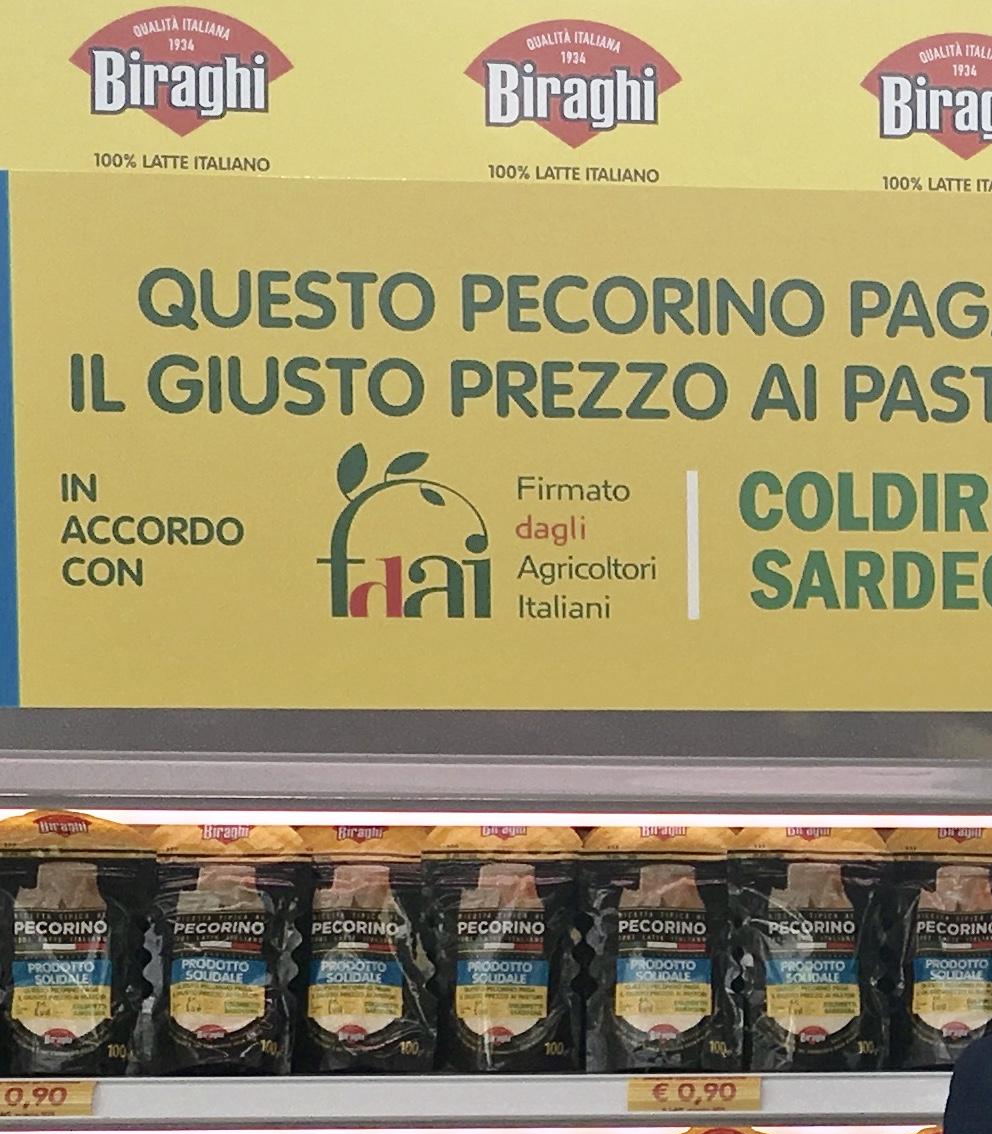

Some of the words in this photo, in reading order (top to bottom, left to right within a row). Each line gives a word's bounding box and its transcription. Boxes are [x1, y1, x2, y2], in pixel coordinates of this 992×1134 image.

[182, 18, 231, 40] ITALIANA
[168, 39, 194, 51] 1934
[574, 31, 621, 53] ITALIANA
[561, 51, 586, 64] 1934
[953, 65, 977, 76] 1934
[89, 47, 269, 119] Biraghi
[485, 61, 658, 131] Biraghi
[94, 153, 136, 168] 100%
[143, 155, 189, 169] LATTE
[195, 156, 270, 172] ITALIANO
[488, 165, 530, 179] 100%
[536, 166, 580, 181] LATTE
[586, 167, 659, 183] ITALIANO
[882, 176, 922, 191] 100%
[929, 177, 971, 192] LATTE
[138, 267, 436, 331] QUESTO
[461, 274, 825, 338] PECORINO
[70, 353, 126, 412] IL
[147, 354, 425, 416] GIUSTO
[450, 359, 729, 421] PREZZO
[751, 363, 817, 422] AI
[60, 472, 98, 502] IN
[517, 476, 630, 501] Firmato
[60, 515, 244, 546] ACCORDO
[515, 514, 586, 546] dagli
[61, 557, 143, 587] CON
[517, 555, 656, 585] Agricoltori
[519, 594, 610, 619] Italiani
[14, 920, 107, 935] PECORINO
[174, 921, 264, 935] PECORINO
[312, 921, 399, 936] PECORINO
[457, 921, 545, 935] PECORINO
[618, 920, 706, 935] PECORINO
[768, 920, 856, 934] PECORINO
[4, 1086, 67, 1111] 0,90
[652, 1083, 669, 1101] €
[678, 1082, 737, 1106] 0,90
